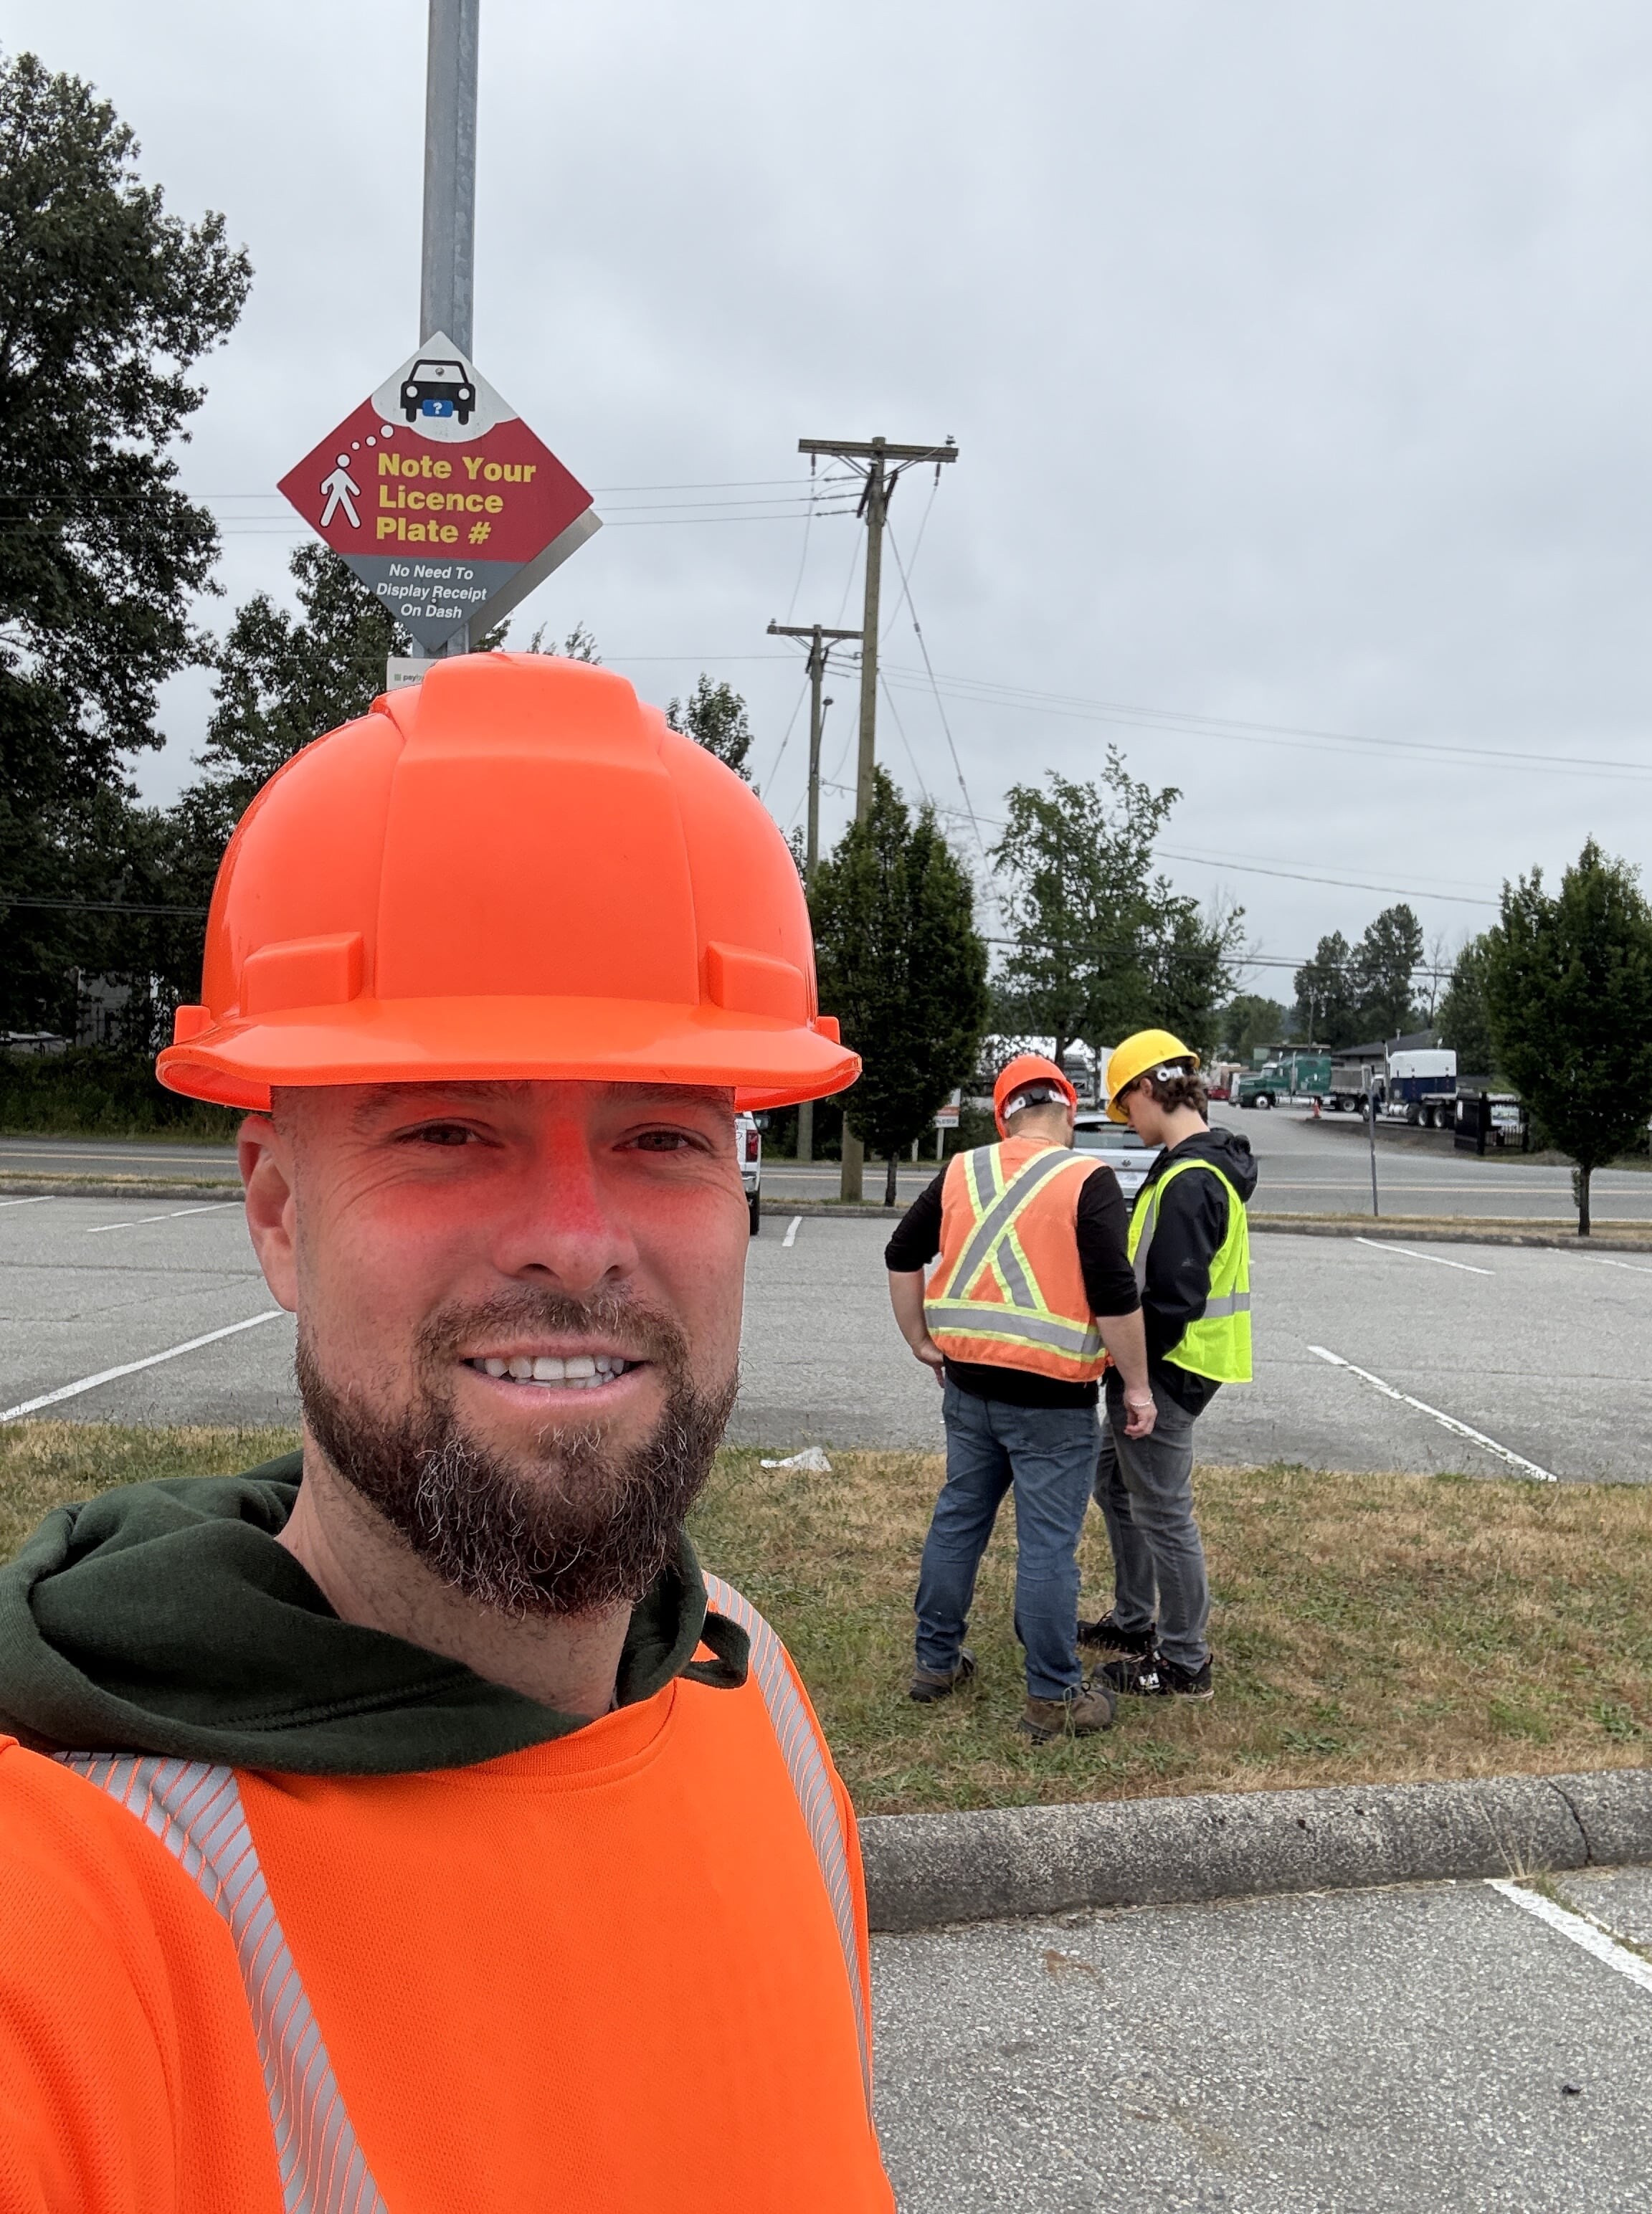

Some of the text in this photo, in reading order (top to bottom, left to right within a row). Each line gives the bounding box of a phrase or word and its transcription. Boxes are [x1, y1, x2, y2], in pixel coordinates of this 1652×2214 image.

[378, 452, 536, 483] Note Your
[379, 485, 503, 513] Licence
[376, 516, 491, 544] Plate #
[389, 563, 474, 580] No Need To
[376, 582, 488, 603] Display Receipt
[400, 603, 462, 619] On Dash
